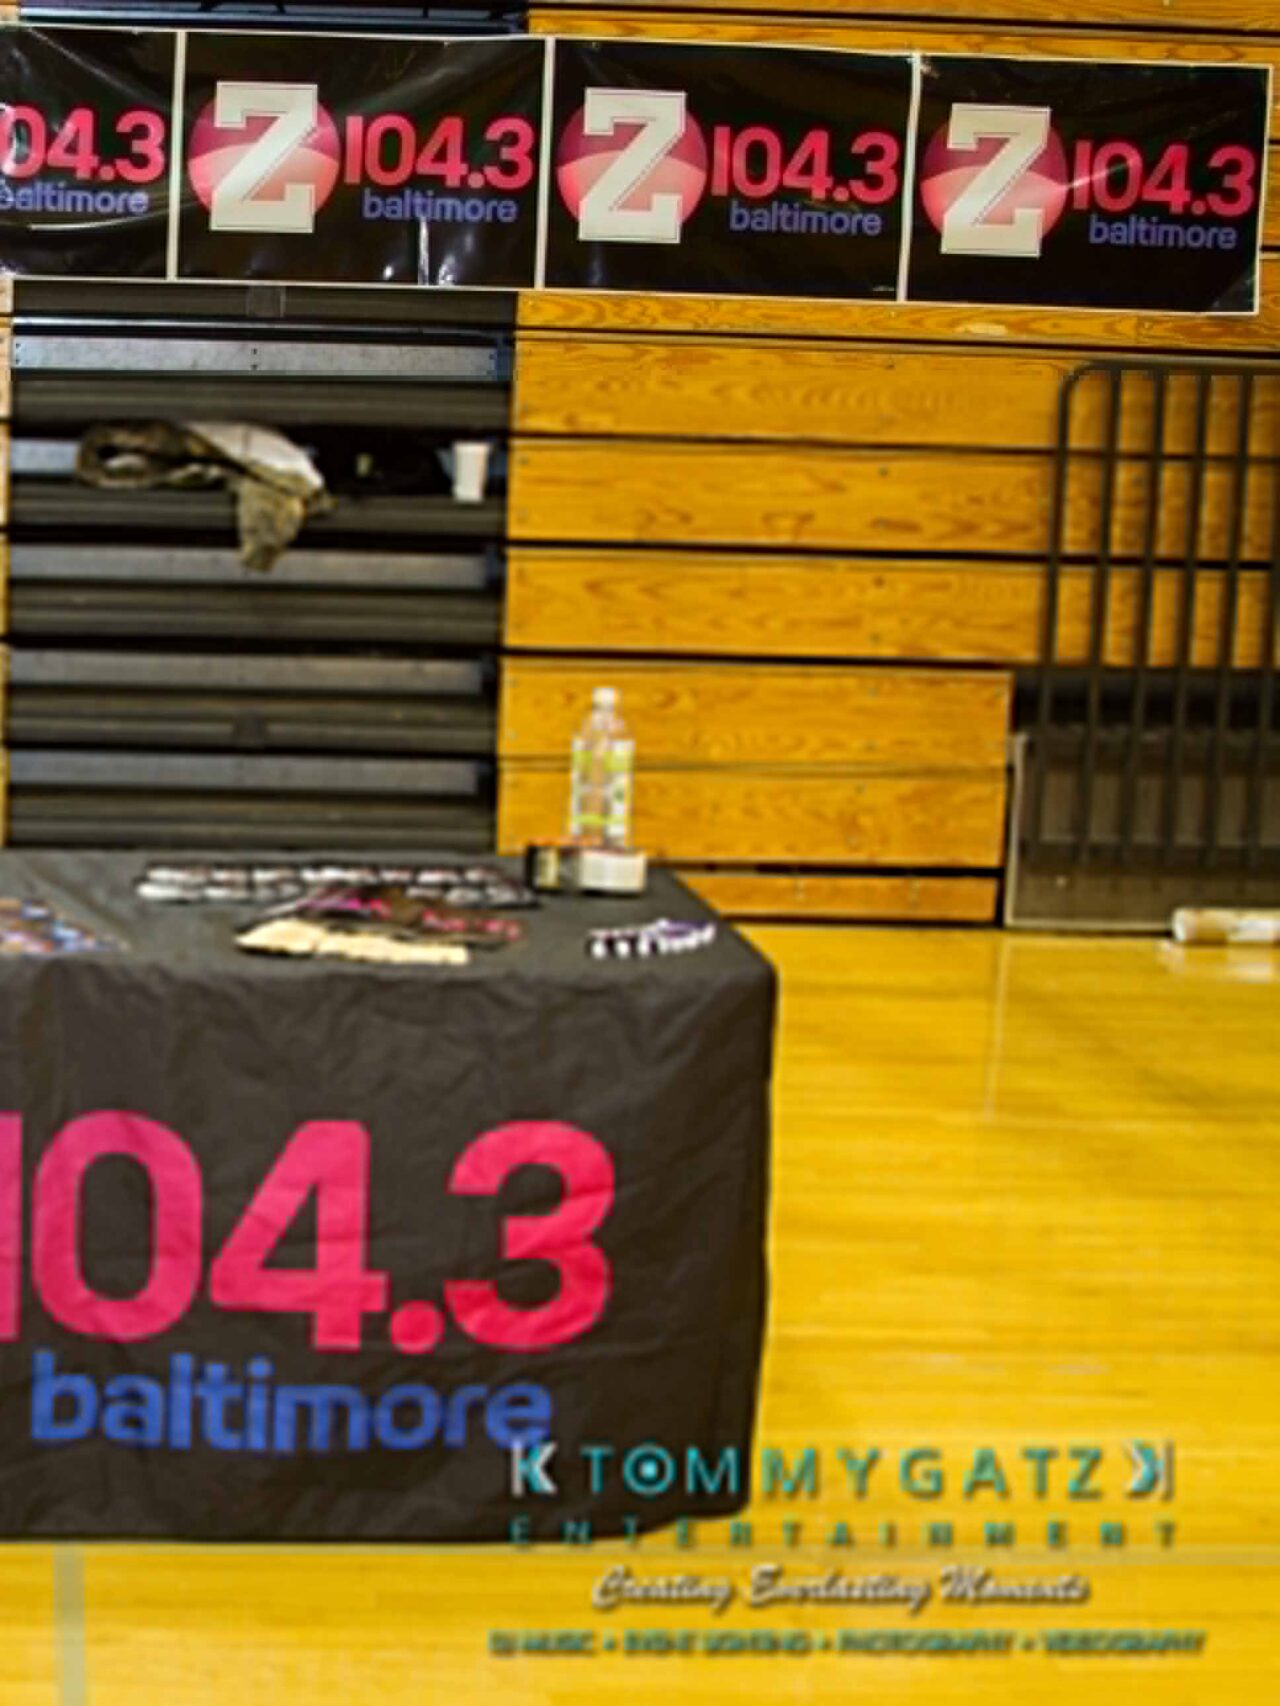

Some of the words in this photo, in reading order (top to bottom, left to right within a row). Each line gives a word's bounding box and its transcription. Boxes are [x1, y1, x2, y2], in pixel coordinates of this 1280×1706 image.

[210, 81, 318, 234] Z
[345, 113, 535, 191] 104.3
[363, 188, 518, 224] baltimore
[578, 87, 687, 244] Z
[709, 125, 900, 204] 104.3
[940, 102, 1052, 258] Z
[1072, 139, 1257, 217] 104.3
[729, 199, 882, 236] baltimore
[1088, 212, 1238, 251] baltimore
[30, 1348, 553, 1452] baltimore
